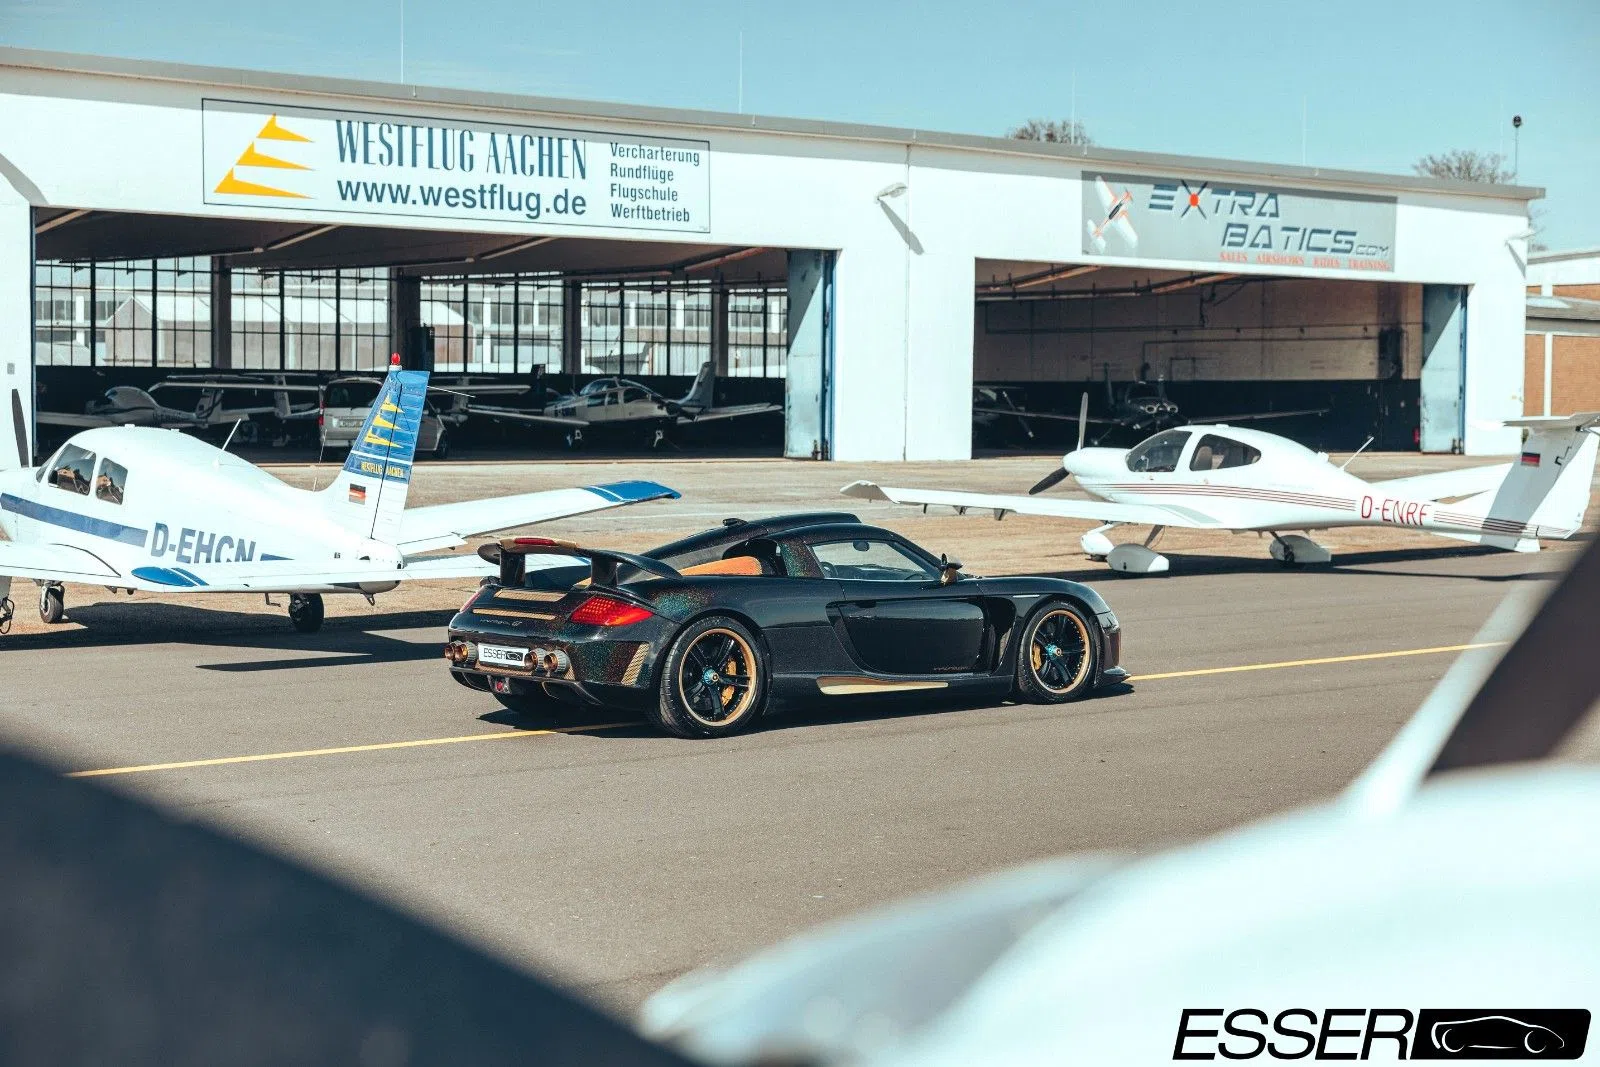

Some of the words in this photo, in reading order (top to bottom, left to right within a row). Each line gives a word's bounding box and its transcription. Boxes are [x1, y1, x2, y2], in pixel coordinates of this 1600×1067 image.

[335, 119, 474, 172] WESTFLUG
[486, 132, 587, 180] AACHEN
[610, 142, 700, 167] Vercharterung
[610, 162, 674, 184] Rundflüge
[336, 180, 587, 220] www.westflug.de
[610, 183, 678, 202] Flugschule
[1148, 180, 1280, 220] EXTRA
[610, 203, 690, 222] Werftbetrieb
[150, 522, 256, 564] D-EHCN
[483, 647, 507, 660] ESSER
